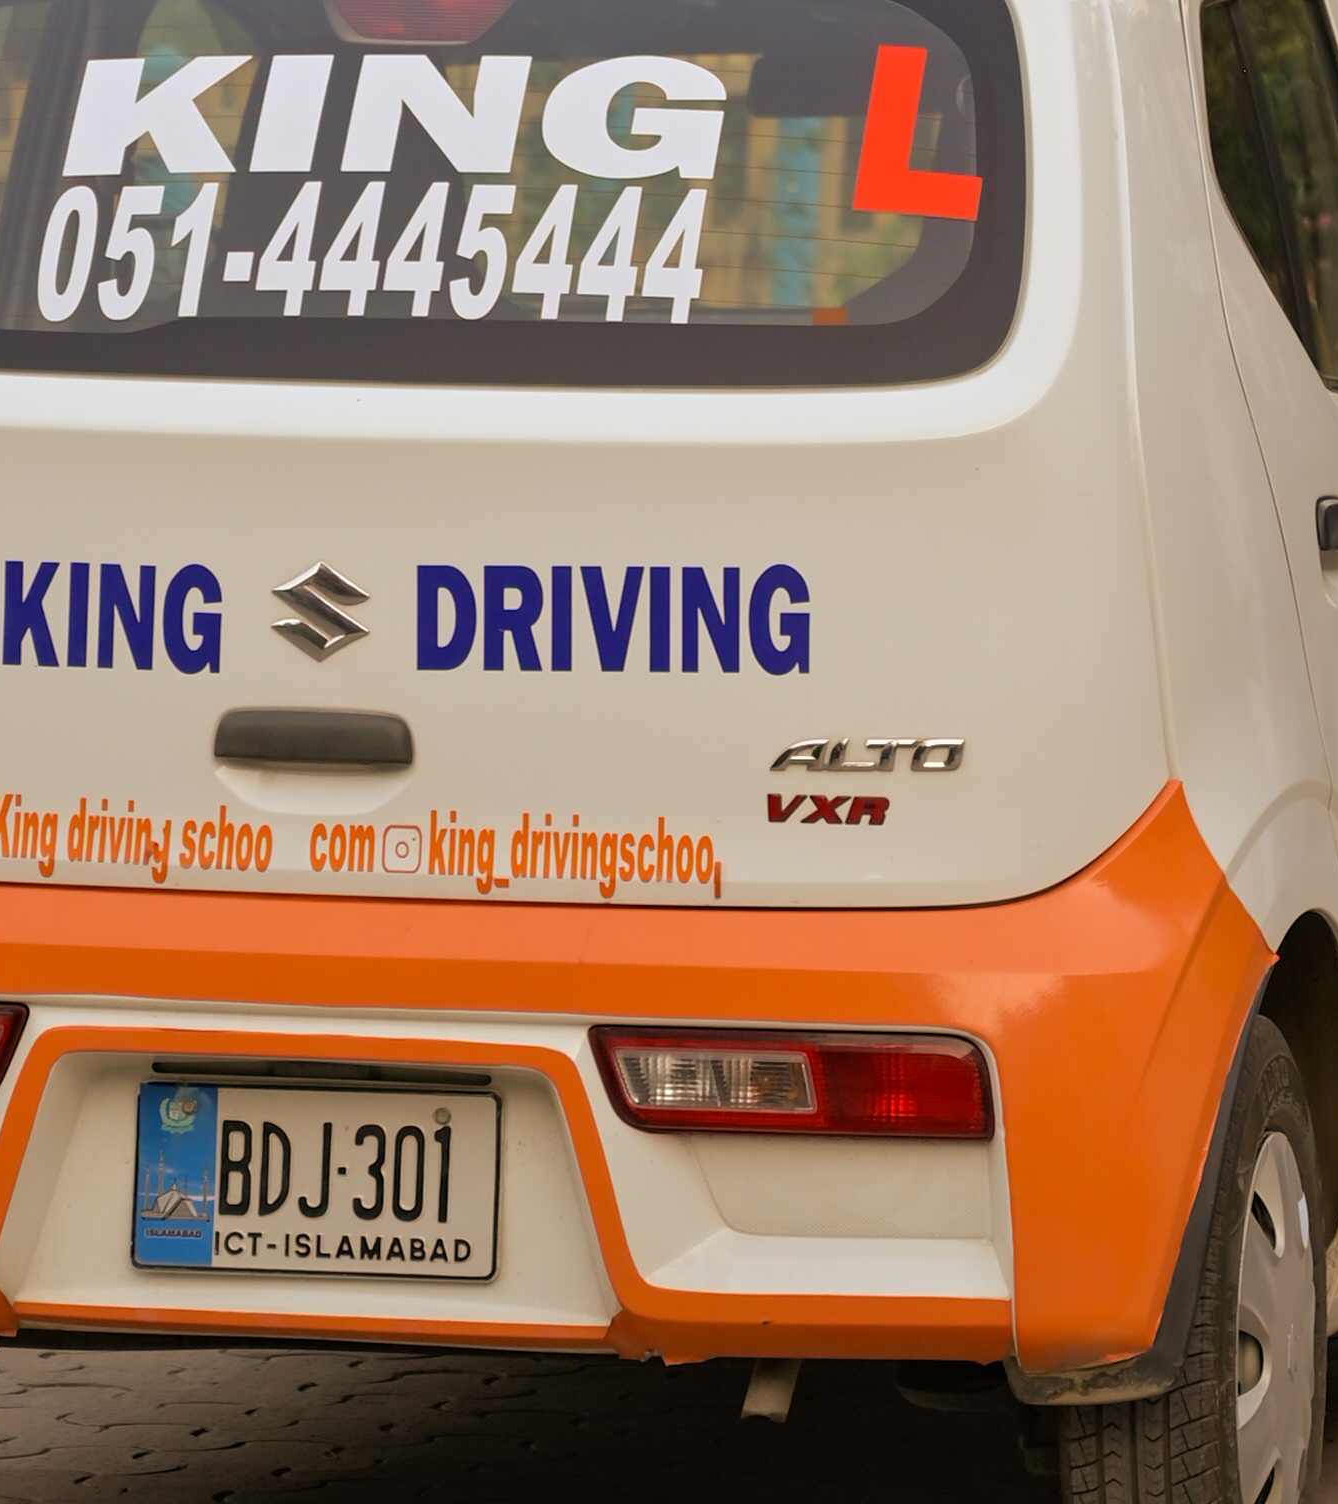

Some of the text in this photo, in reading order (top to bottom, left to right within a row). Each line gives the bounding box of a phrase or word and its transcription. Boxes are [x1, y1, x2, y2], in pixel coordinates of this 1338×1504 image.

[62, 54, 727, 180] KING
[852, 45, 983, 221] L
[38, 182, 708, 324] 051-4445444
[3, 559, 810, 675] KING DRIVING
[767, 793, 890, 825] VXR
[769, 737, 965, 772] ALTO
[214, 1231, 472, 1263] ICT-ISLAMABAD
